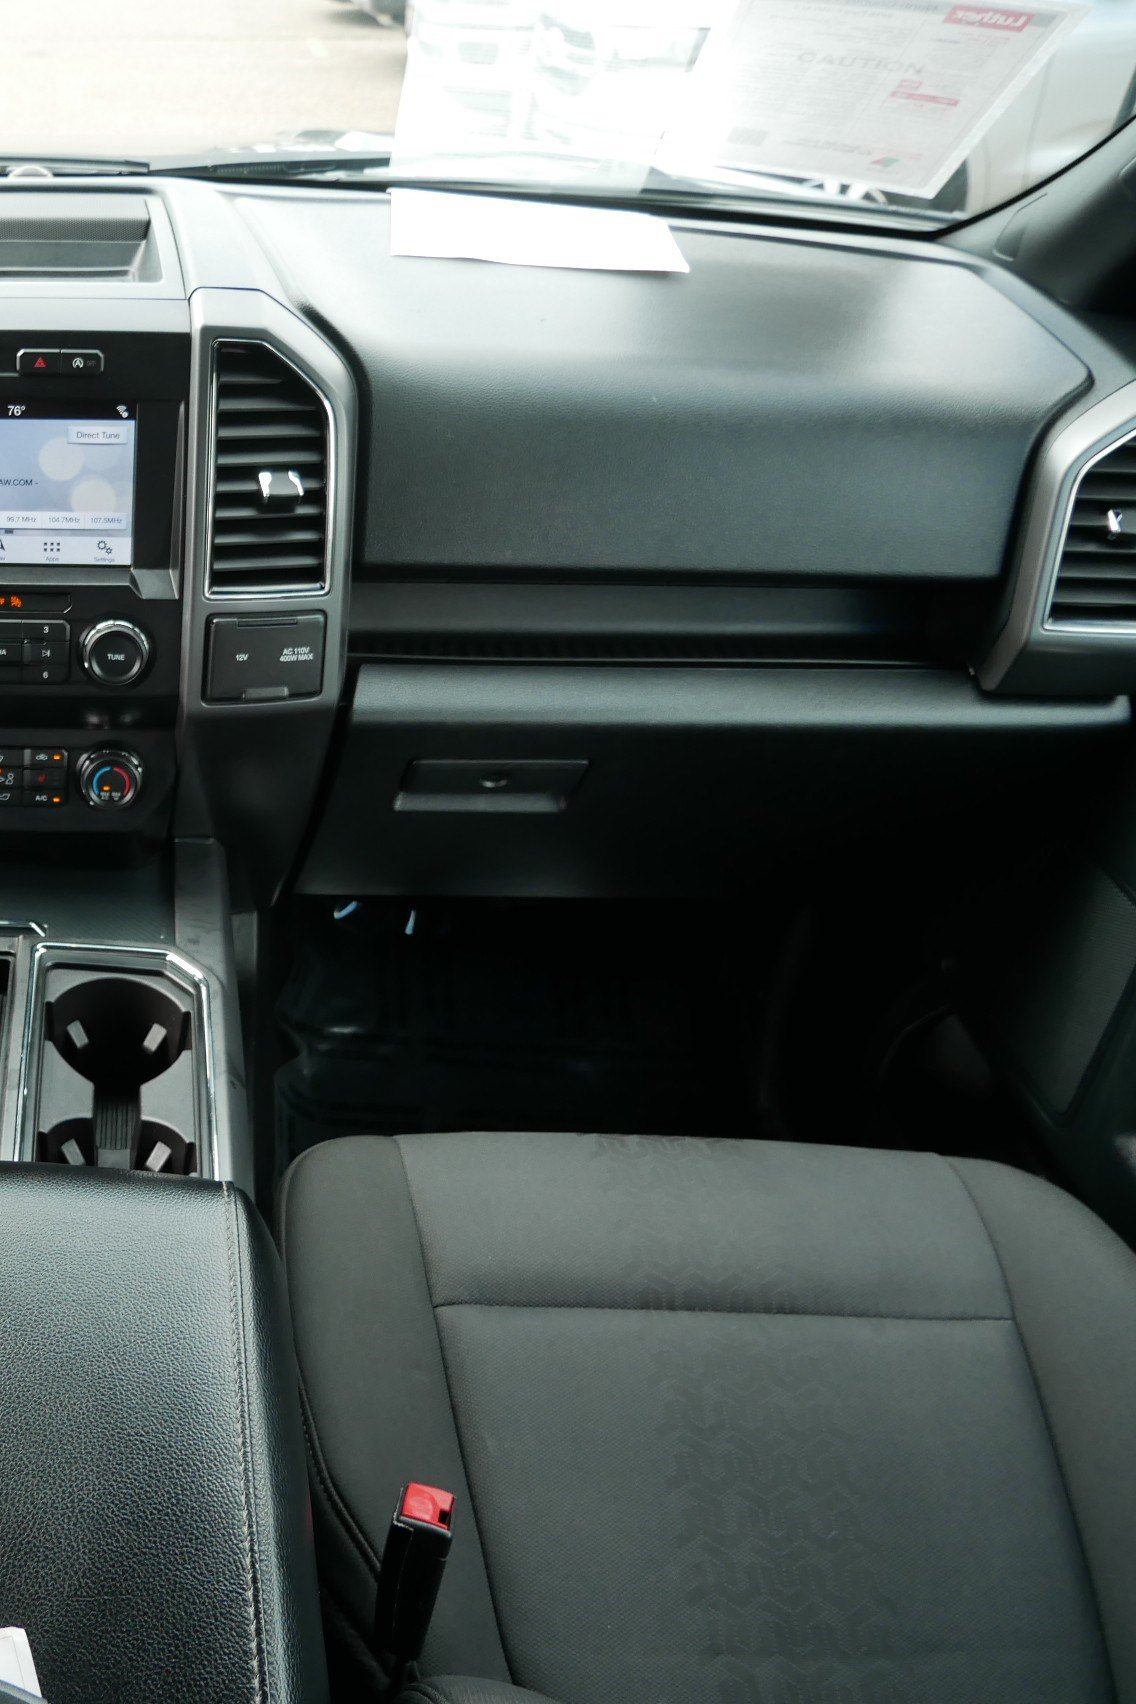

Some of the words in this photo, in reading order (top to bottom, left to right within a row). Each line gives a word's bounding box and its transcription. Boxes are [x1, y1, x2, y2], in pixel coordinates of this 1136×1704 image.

[798, 52, 925, 75] CAUTION
[76, 431, 99, 439] Direct
[280, 654, 298, 662] 400W
[43, 671, 49, 679] 6
